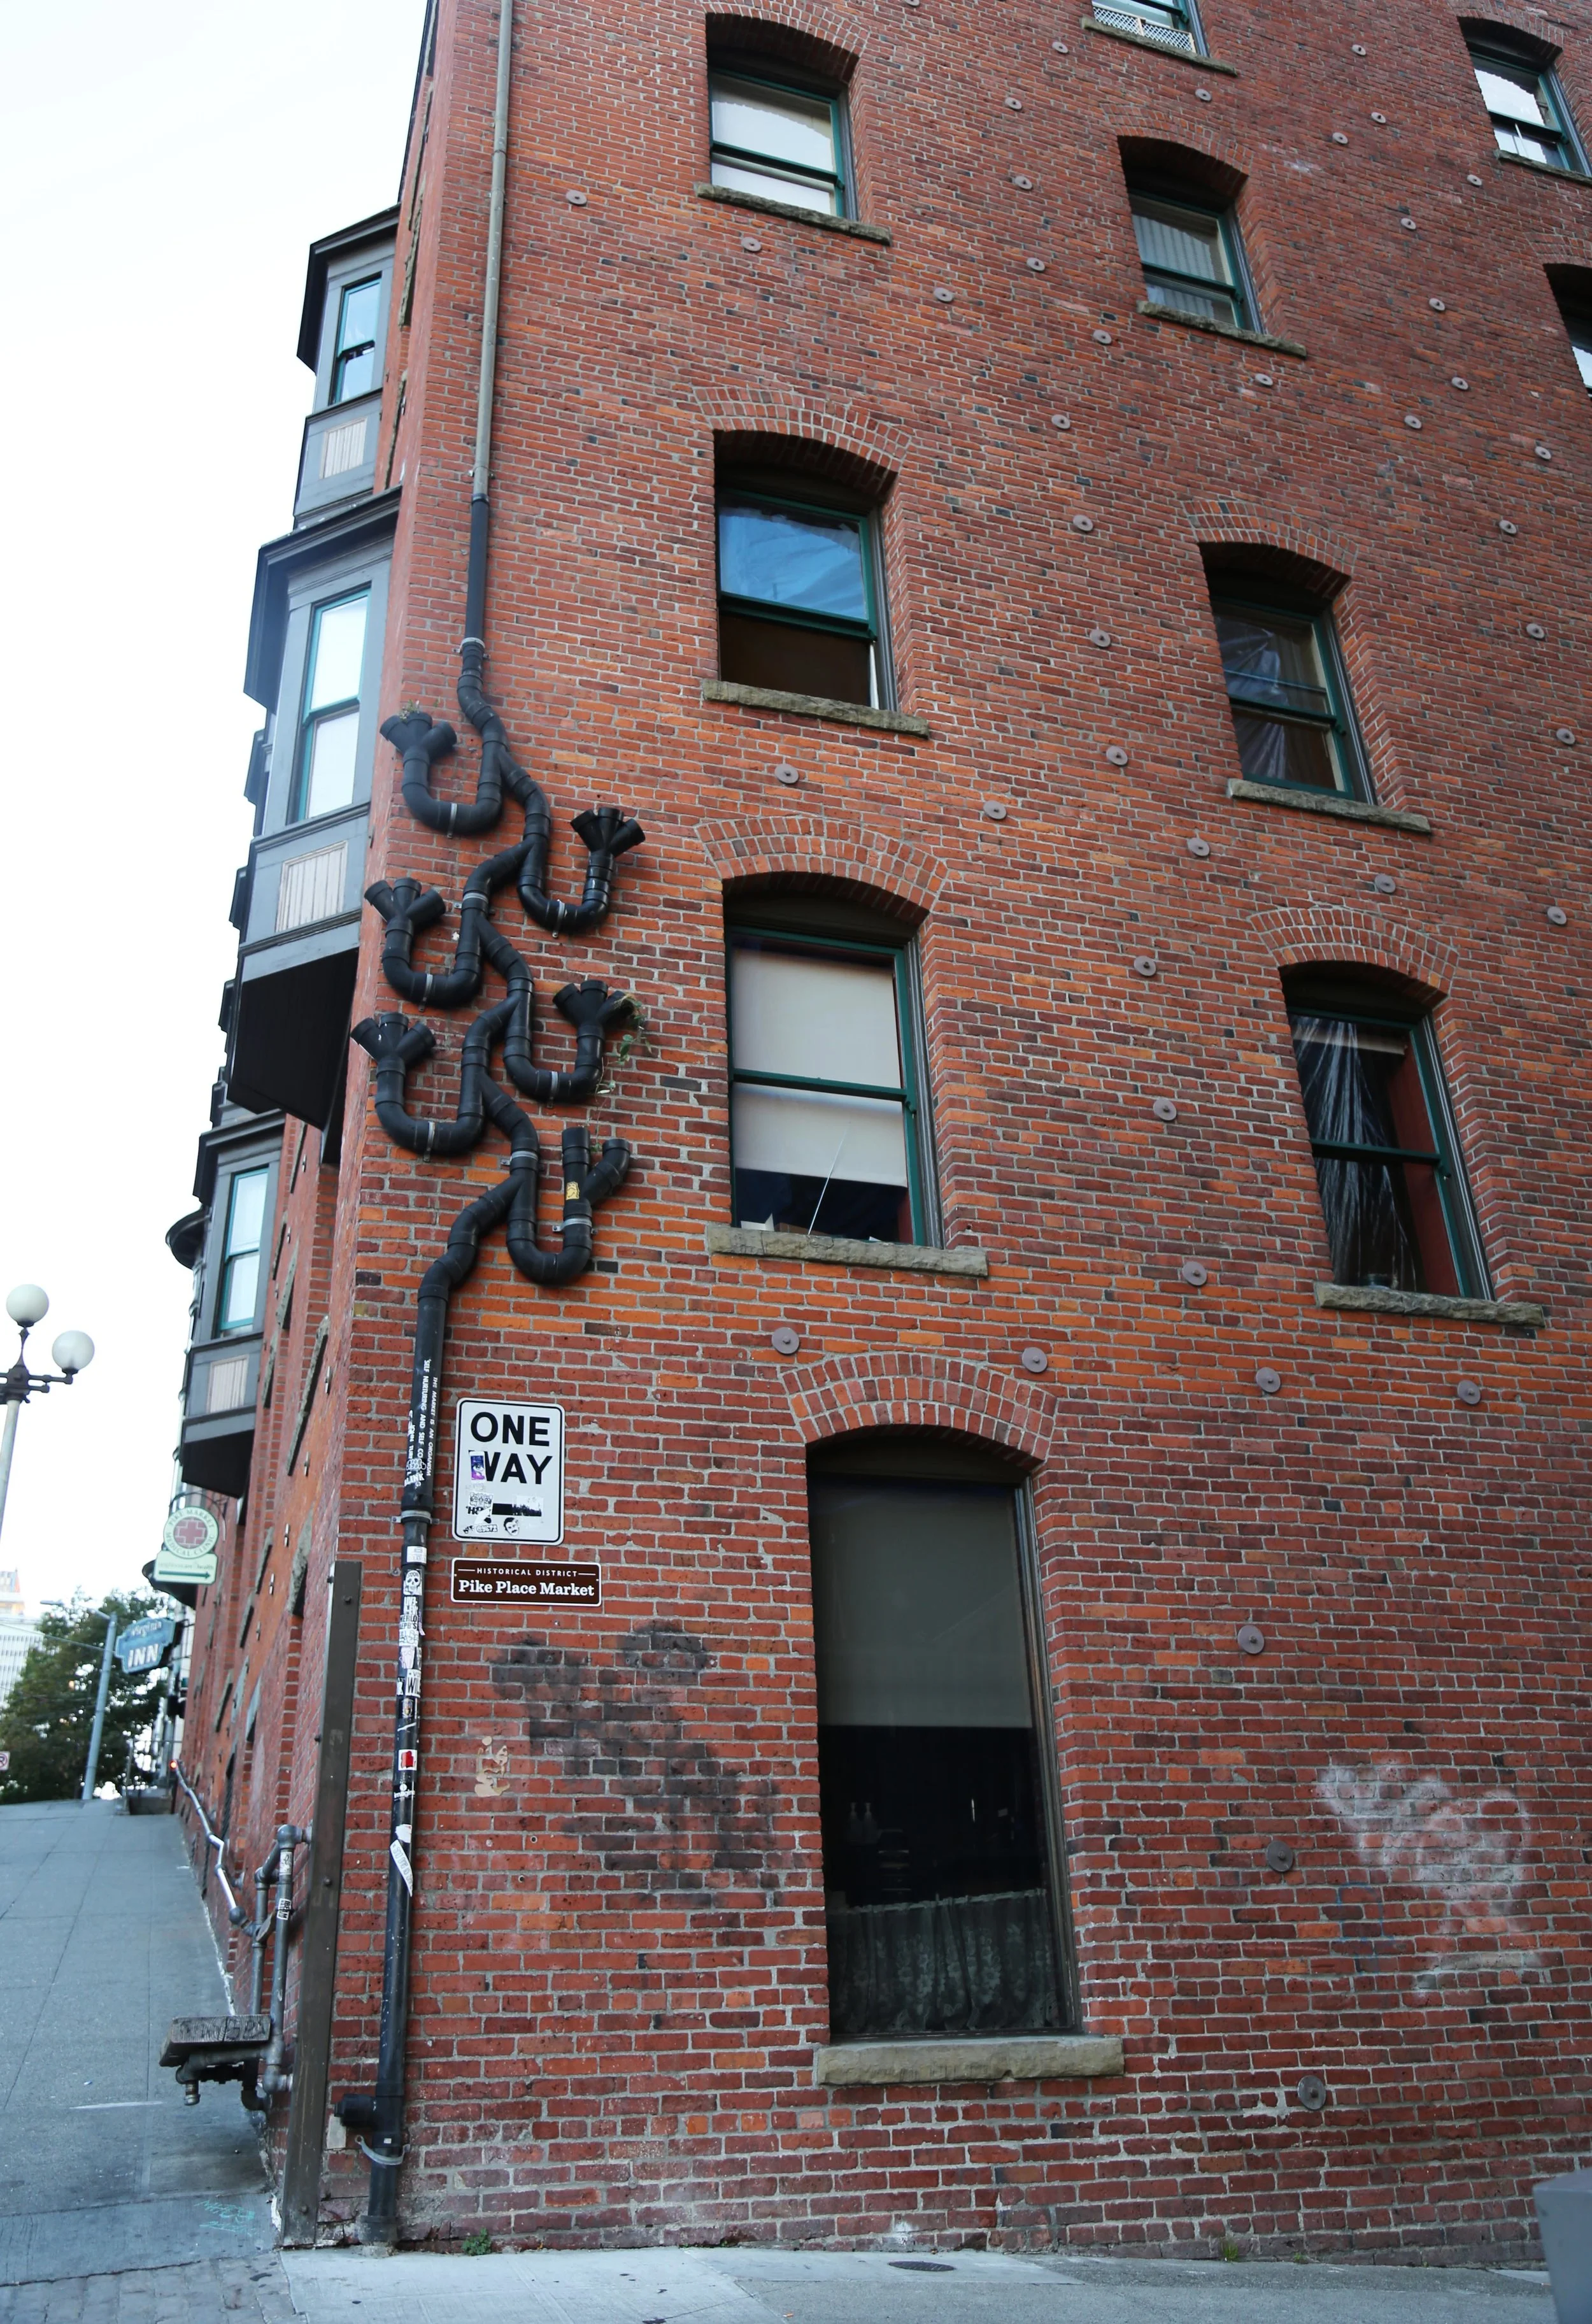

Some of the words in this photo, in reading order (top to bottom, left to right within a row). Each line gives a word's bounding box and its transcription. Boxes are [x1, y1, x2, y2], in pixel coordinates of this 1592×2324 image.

[421, 1376, 429, 1411] NURTURING
[429, 1428, 434, 1439] AN
[471, 1411, 550, 1447] ONE
[187, 1508, 216, 1528] MARKET
[166, 1532, 192, 1557] MEDICAL
[194, 1534, 215, 1555] CLINIC
[477, 1567, 532, 1576] HISTORICAL
[458, 1579, 493, 1593] Pike
[495, 1581, 537, 1594] Place
[539, 1582, 595, 1596] Market
[128, 1644, 159, 1667] INN
